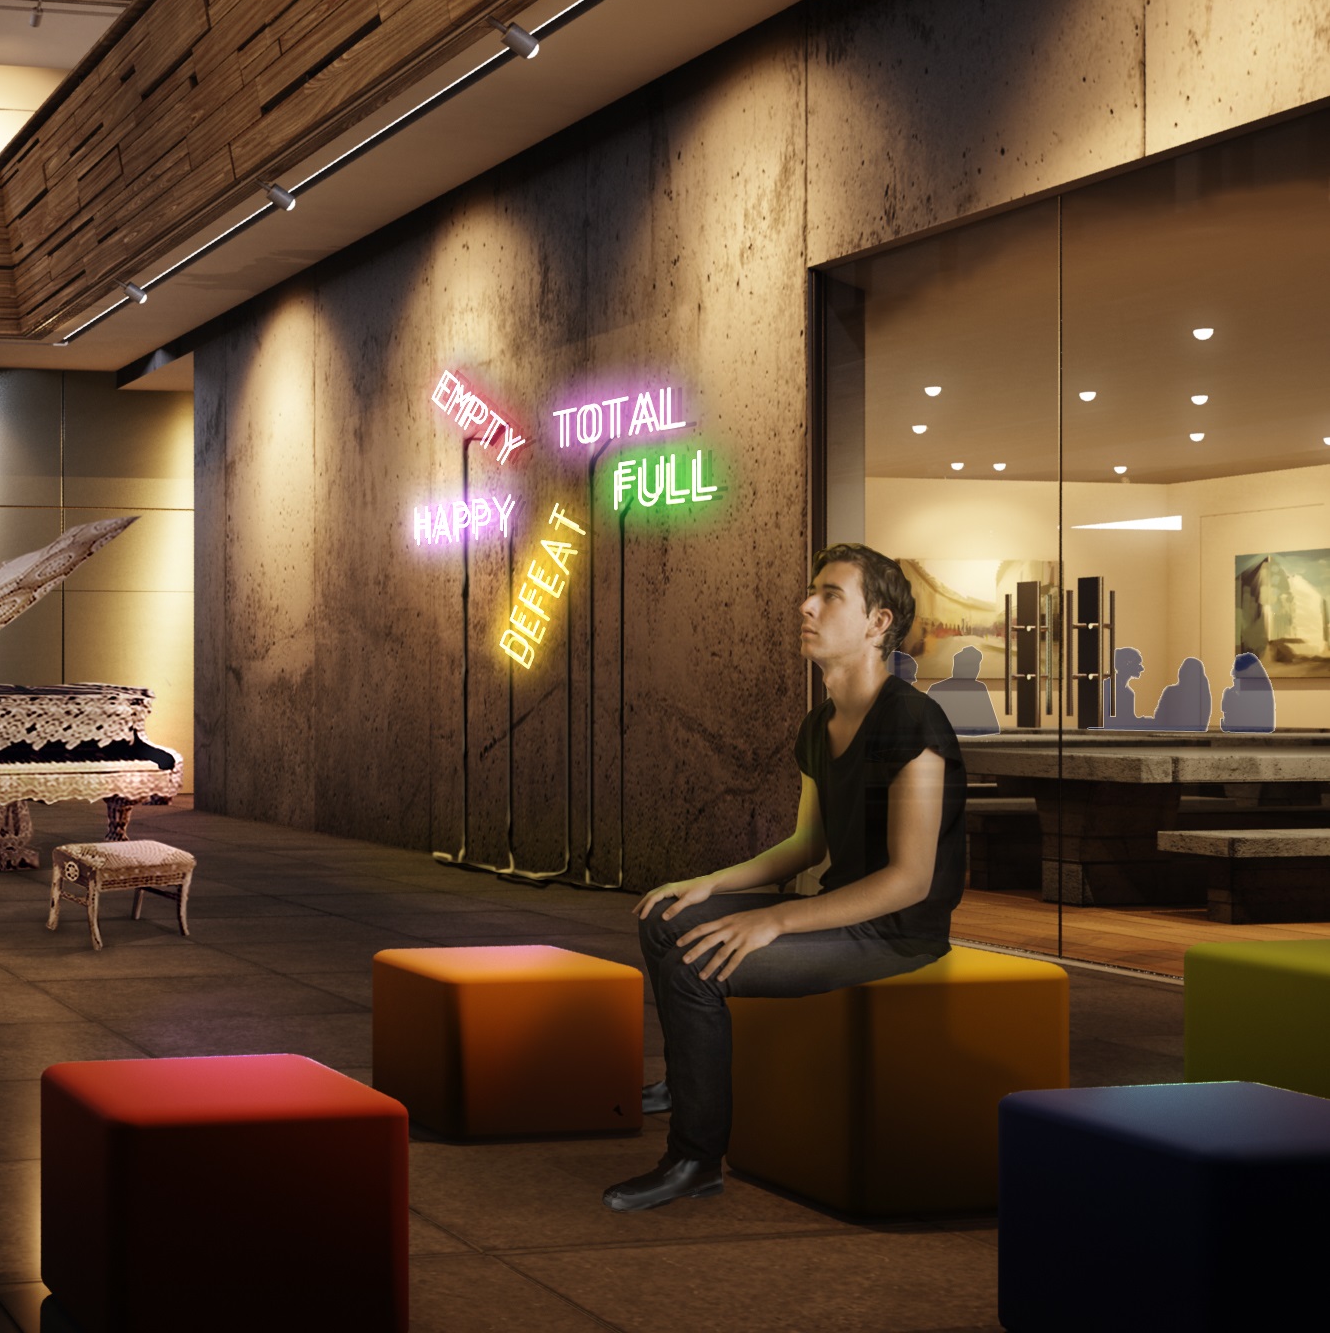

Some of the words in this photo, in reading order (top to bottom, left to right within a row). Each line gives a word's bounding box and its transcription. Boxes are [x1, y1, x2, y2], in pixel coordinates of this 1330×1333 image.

[431, 369, 526, 465] EMPTY
[553, 386, 687, 449] TOTAL
[613, 449, 718, 511] FULL
[412, 493, 516, 546] HAPPY
[498, 502, 587, 670] DEFEAT
